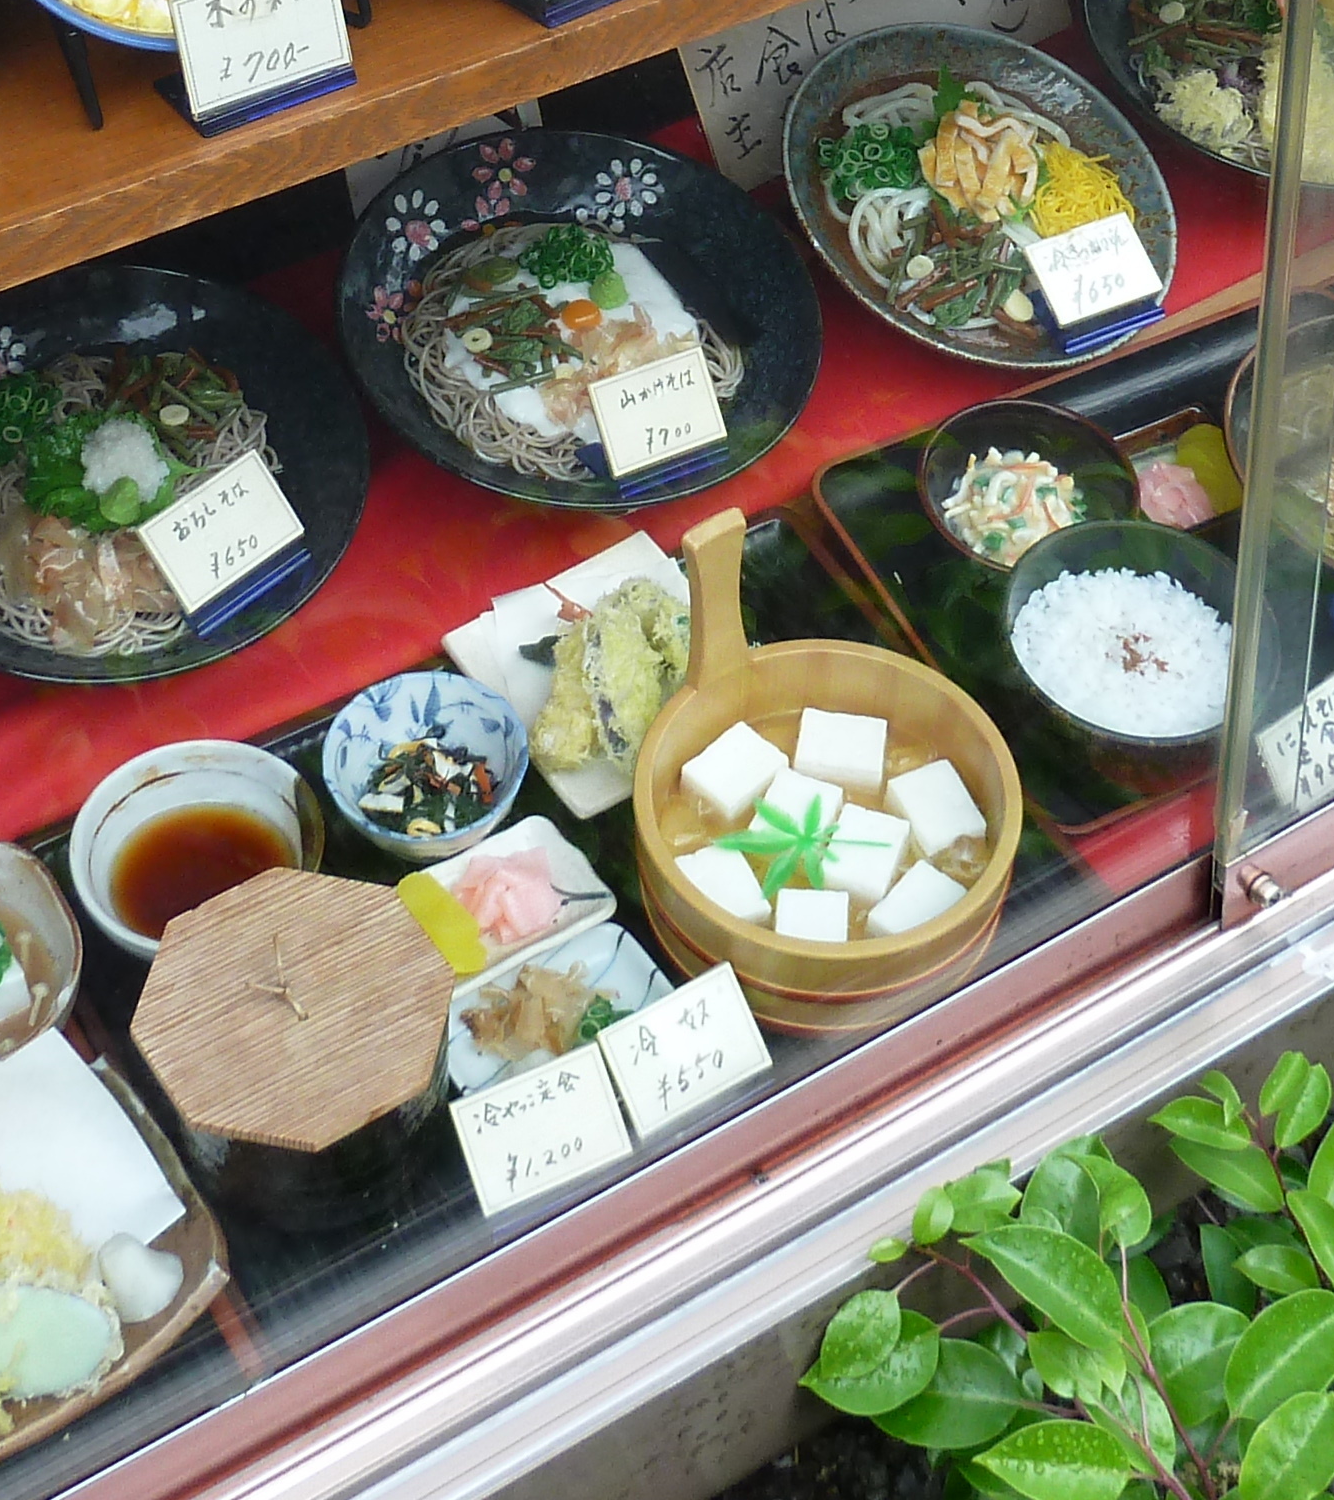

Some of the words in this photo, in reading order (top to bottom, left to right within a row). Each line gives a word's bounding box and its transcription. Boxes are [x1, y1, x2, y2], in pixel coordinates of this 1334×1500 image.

[645, 422, 691, 454] ¥700
[210, 534, 258, 579] ¥650
[657, 1050, 724, 1110] ¥550
